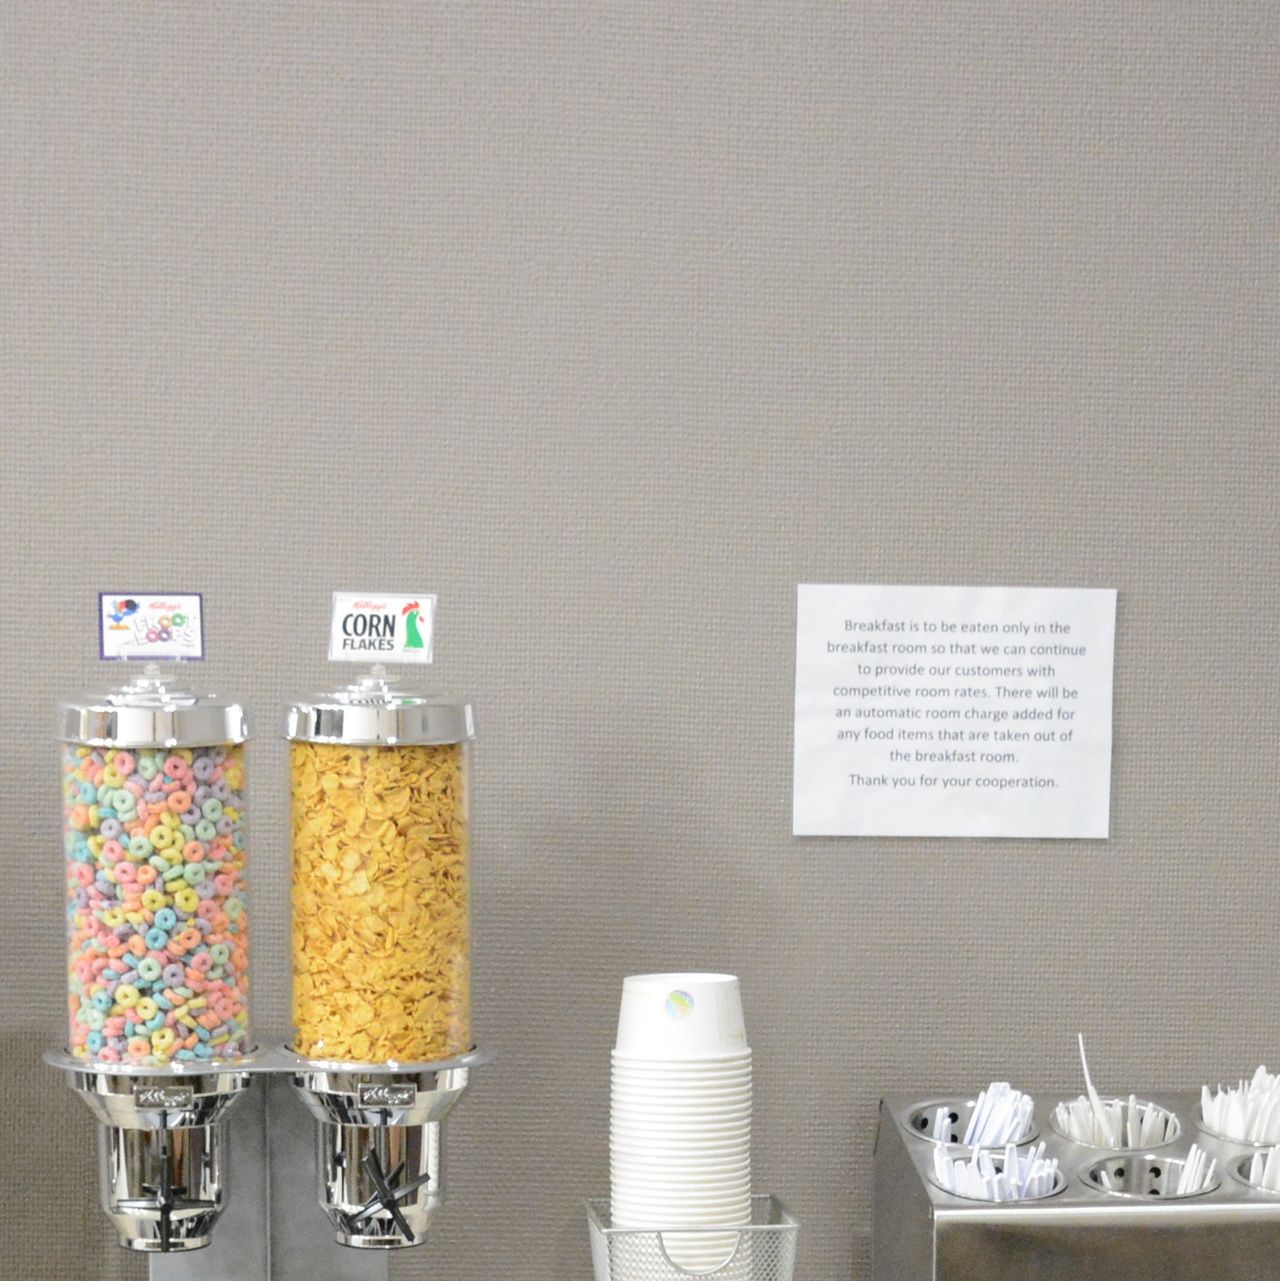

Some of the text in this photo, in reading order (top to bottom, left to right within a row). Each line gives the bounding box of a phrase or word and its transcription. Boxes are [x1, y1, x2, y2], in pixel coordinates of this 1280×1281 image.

[342, 613, 396, 637] CORN
[844, 618, 1071, 637] Breakfast is to be eaten only in the
[342, 638, 395, 651] FLAKES
[826, 639, 1087, 657] breakfast room so that we can continue
[857, 663, 1056, 679] to provide our customers with
[832, 685, 1079, 700] competitive room rates. There will be
[835, 707, 1076, 723] an automatic room charge added for
[836, 726, 1074, 743] any food items that are taken out of
[889, 749, 1018, 764] the breakfast room.
[849, 773, 1058, 791] Thank you for your cooperation.
